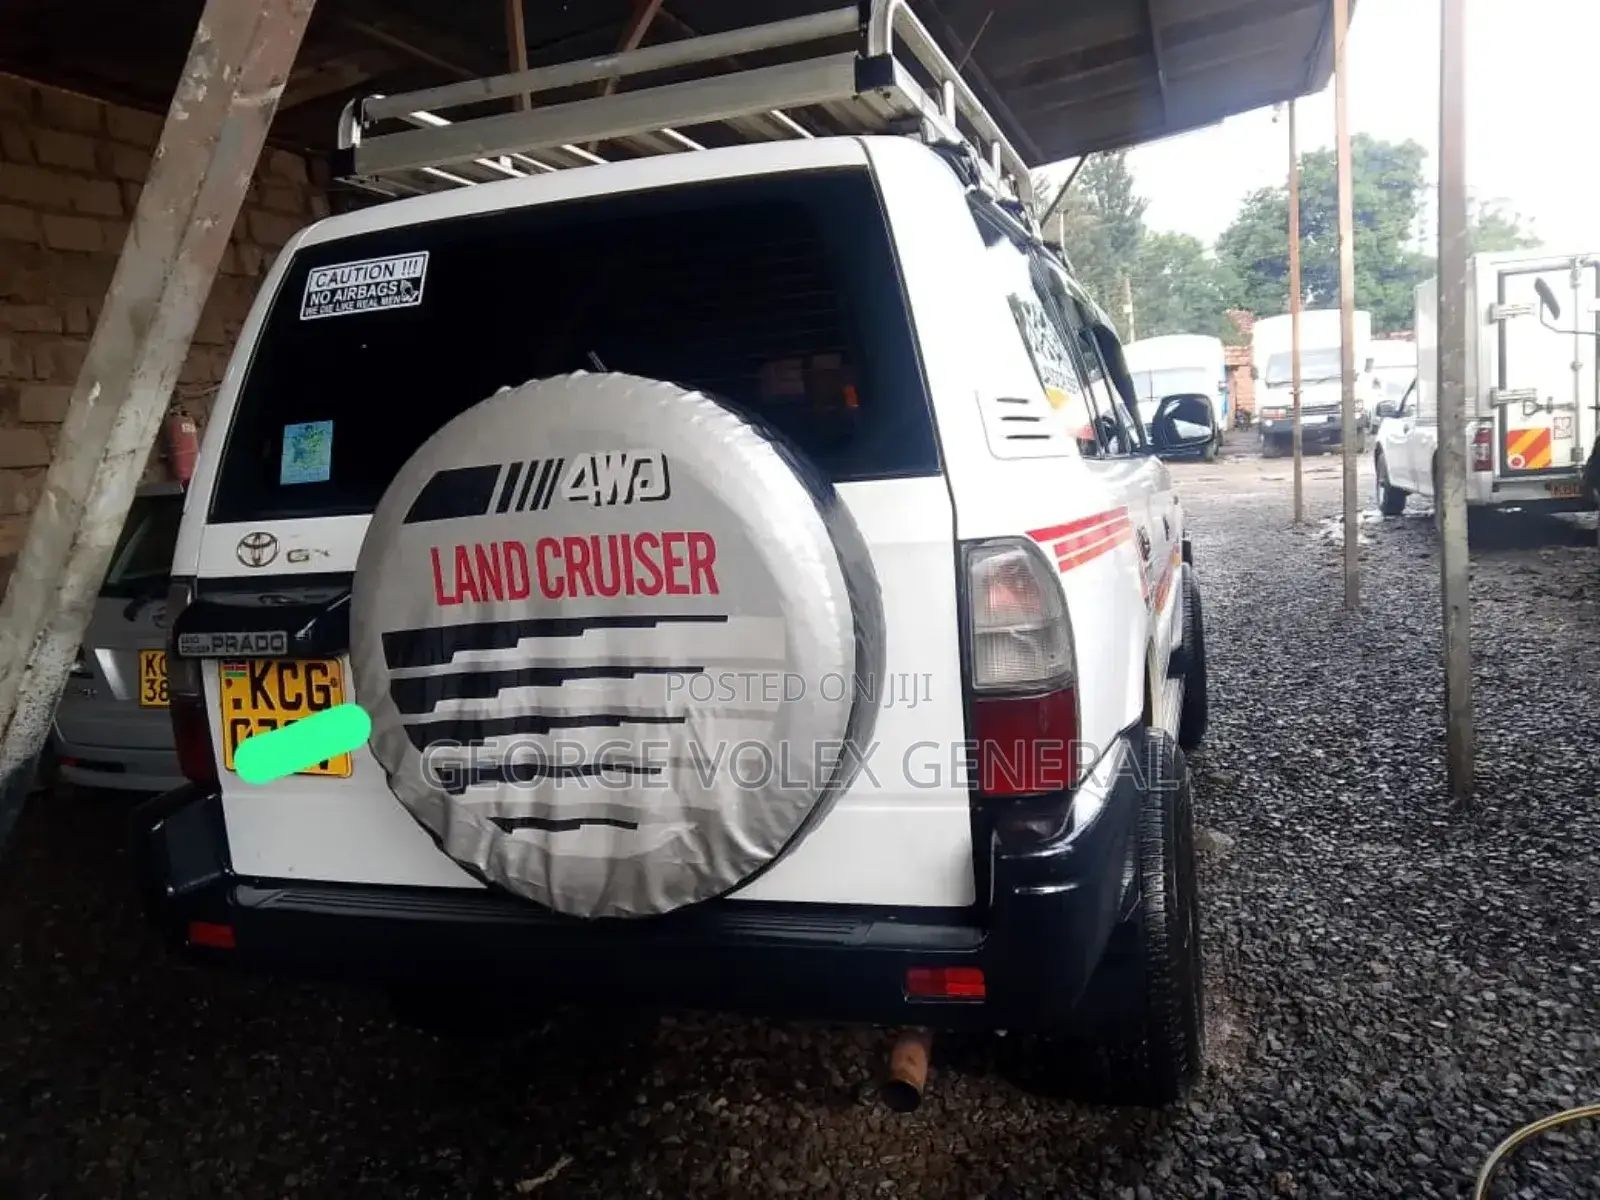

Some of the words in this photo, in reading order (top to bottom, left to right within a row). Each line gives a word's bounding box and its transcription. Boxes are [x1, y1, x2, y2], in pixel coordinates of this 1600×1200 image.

[316, 263, 396, 288] CAUTION
[402, 259, 418, 276] !!!
[310, 290, 331, 306] NO
[333, 281, 398, 303] AIRBAGS
[335, 300, 355, 312] LIKE
[560, 449, 671, 507] 4WD
[430, 540, 530, 606] LAND
[536, 532, 720, 600] CRUISER
[211, 632, 285, 653] PRADO
